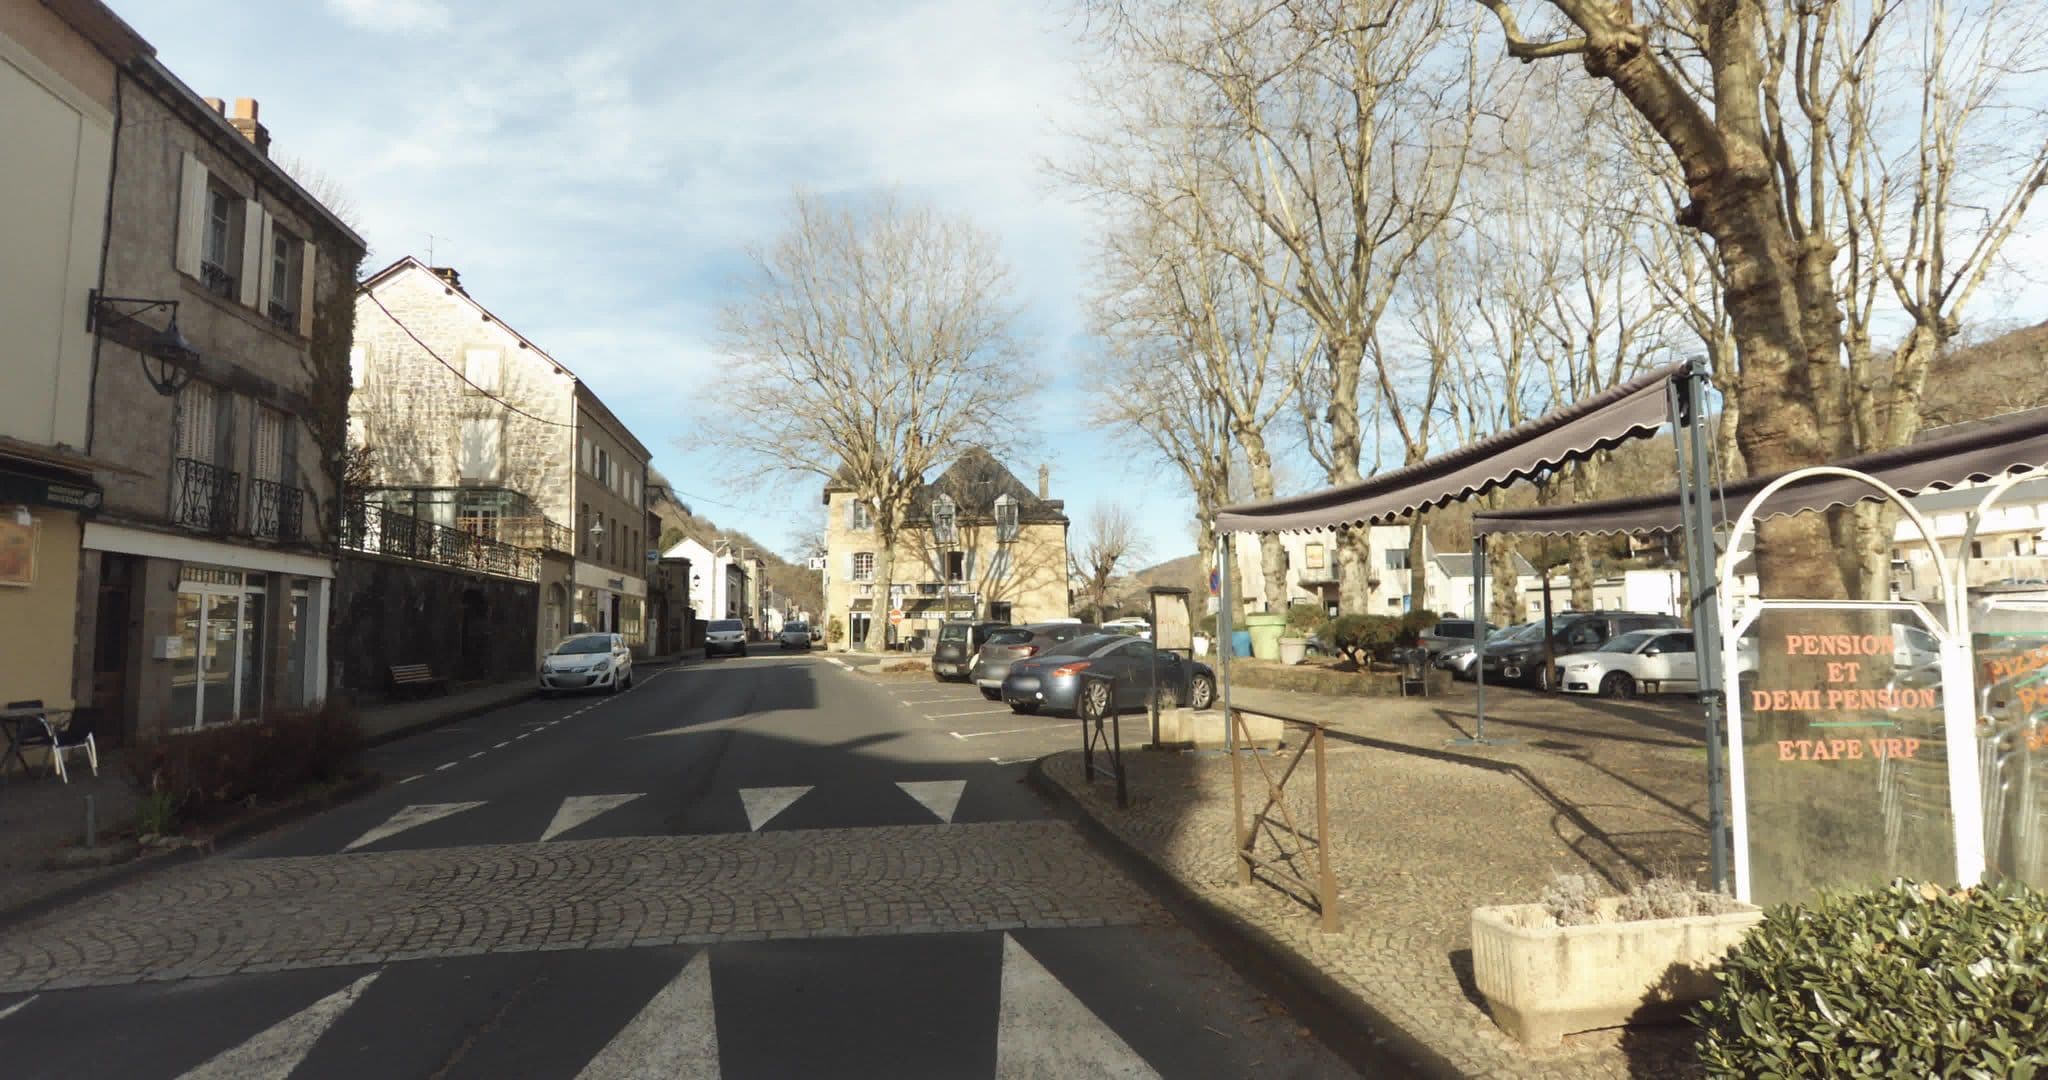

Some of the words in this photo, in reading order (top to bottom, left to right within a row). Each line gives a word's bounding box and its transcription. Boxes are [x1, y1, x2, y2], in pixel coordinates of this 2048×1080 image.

[1786, 634, 1895, 656] PENSION
[1827, 662, 1861, 683] ET
[1751, 690, 1820, 712] DEMI
[1828, 688, 1936, 711] PENSION
[1777, 739, 1863, 761] ETAPE
[1869, 737, 1921, 760] VRP
